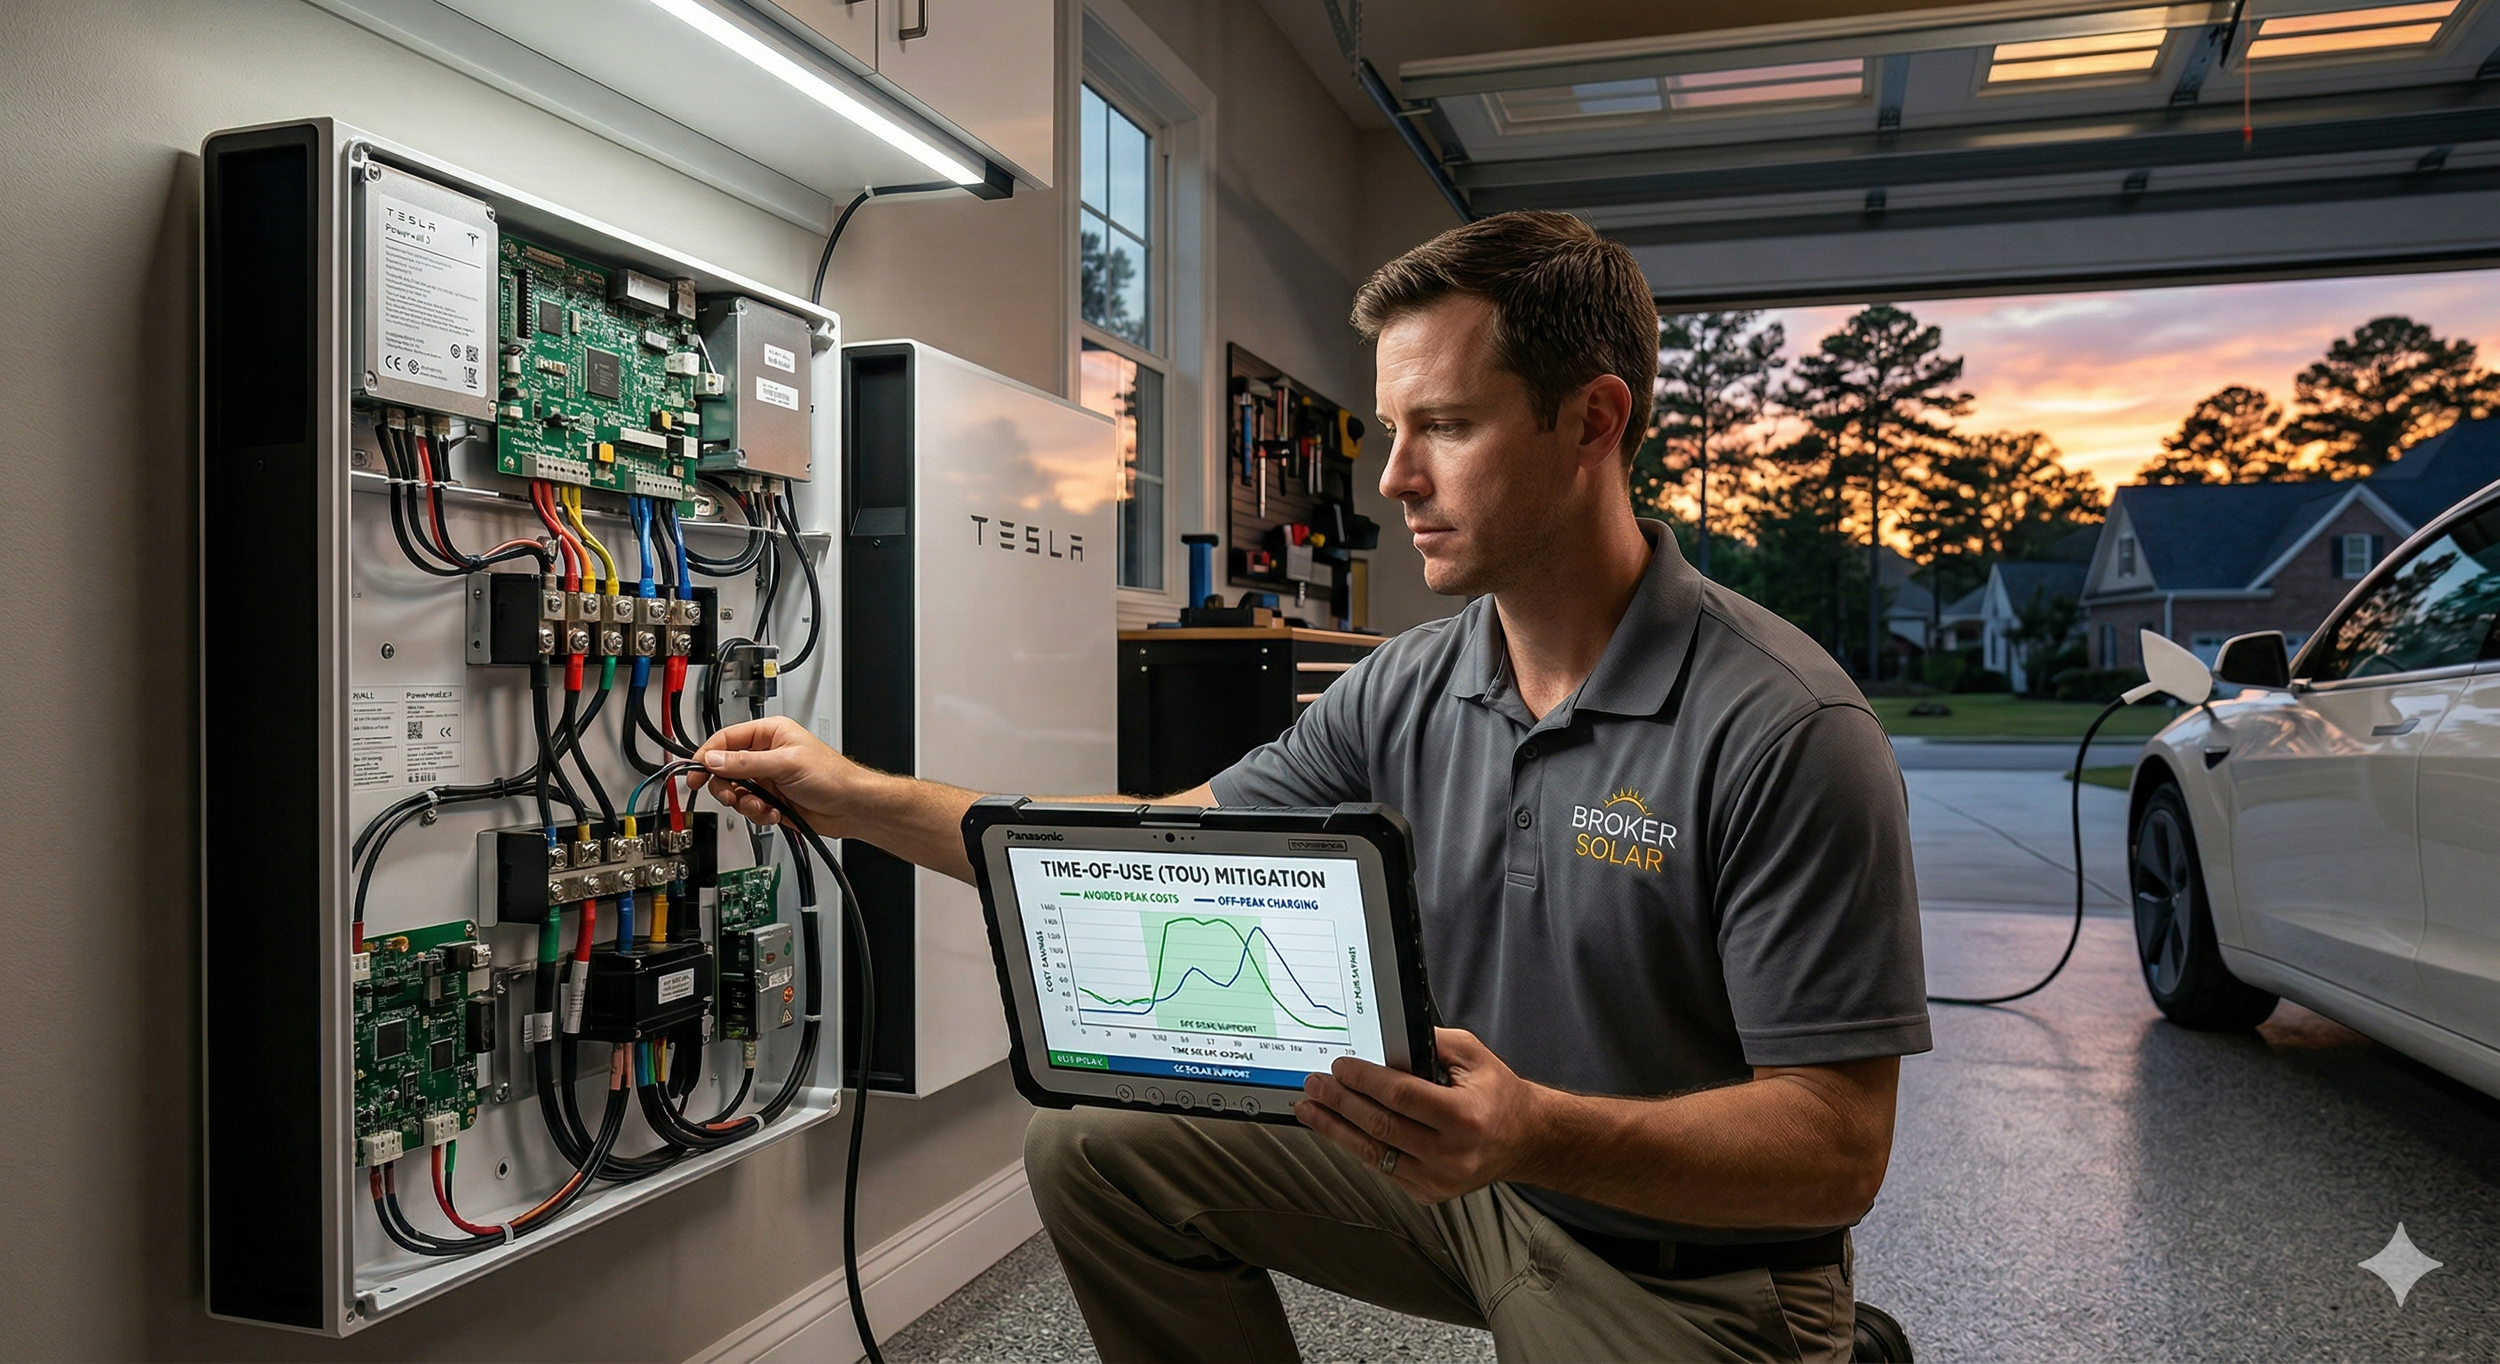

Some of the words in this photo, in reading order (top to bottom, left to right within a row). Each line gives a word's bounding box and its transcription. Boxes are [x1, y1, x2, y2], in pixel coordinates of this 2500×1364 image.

[386, 207, 436, 232] TESLA
[970, 515, 1083, 562] TESLA
[1007, 830, 1064, 842] Panasonic
[1572, 805, 1676, 849] BROKER
[1575, 833, 1664, 873] SOLAR
[1041, 860, 1153, 881] TIME-OF-USE
[1158, 865, 1210, 886] (TOU)
[1214, 867, 1326, 888] MITIGATION
[1083, 890, 1123, 901] AVOIDED
[1125, 891, 1149, 902] PEAK
[1150, 893, 1179, 904] COSTS
[1218, 896, 1265, 908] OFF-PEAK
[1267, 898, 1319, 910] CHARGING
